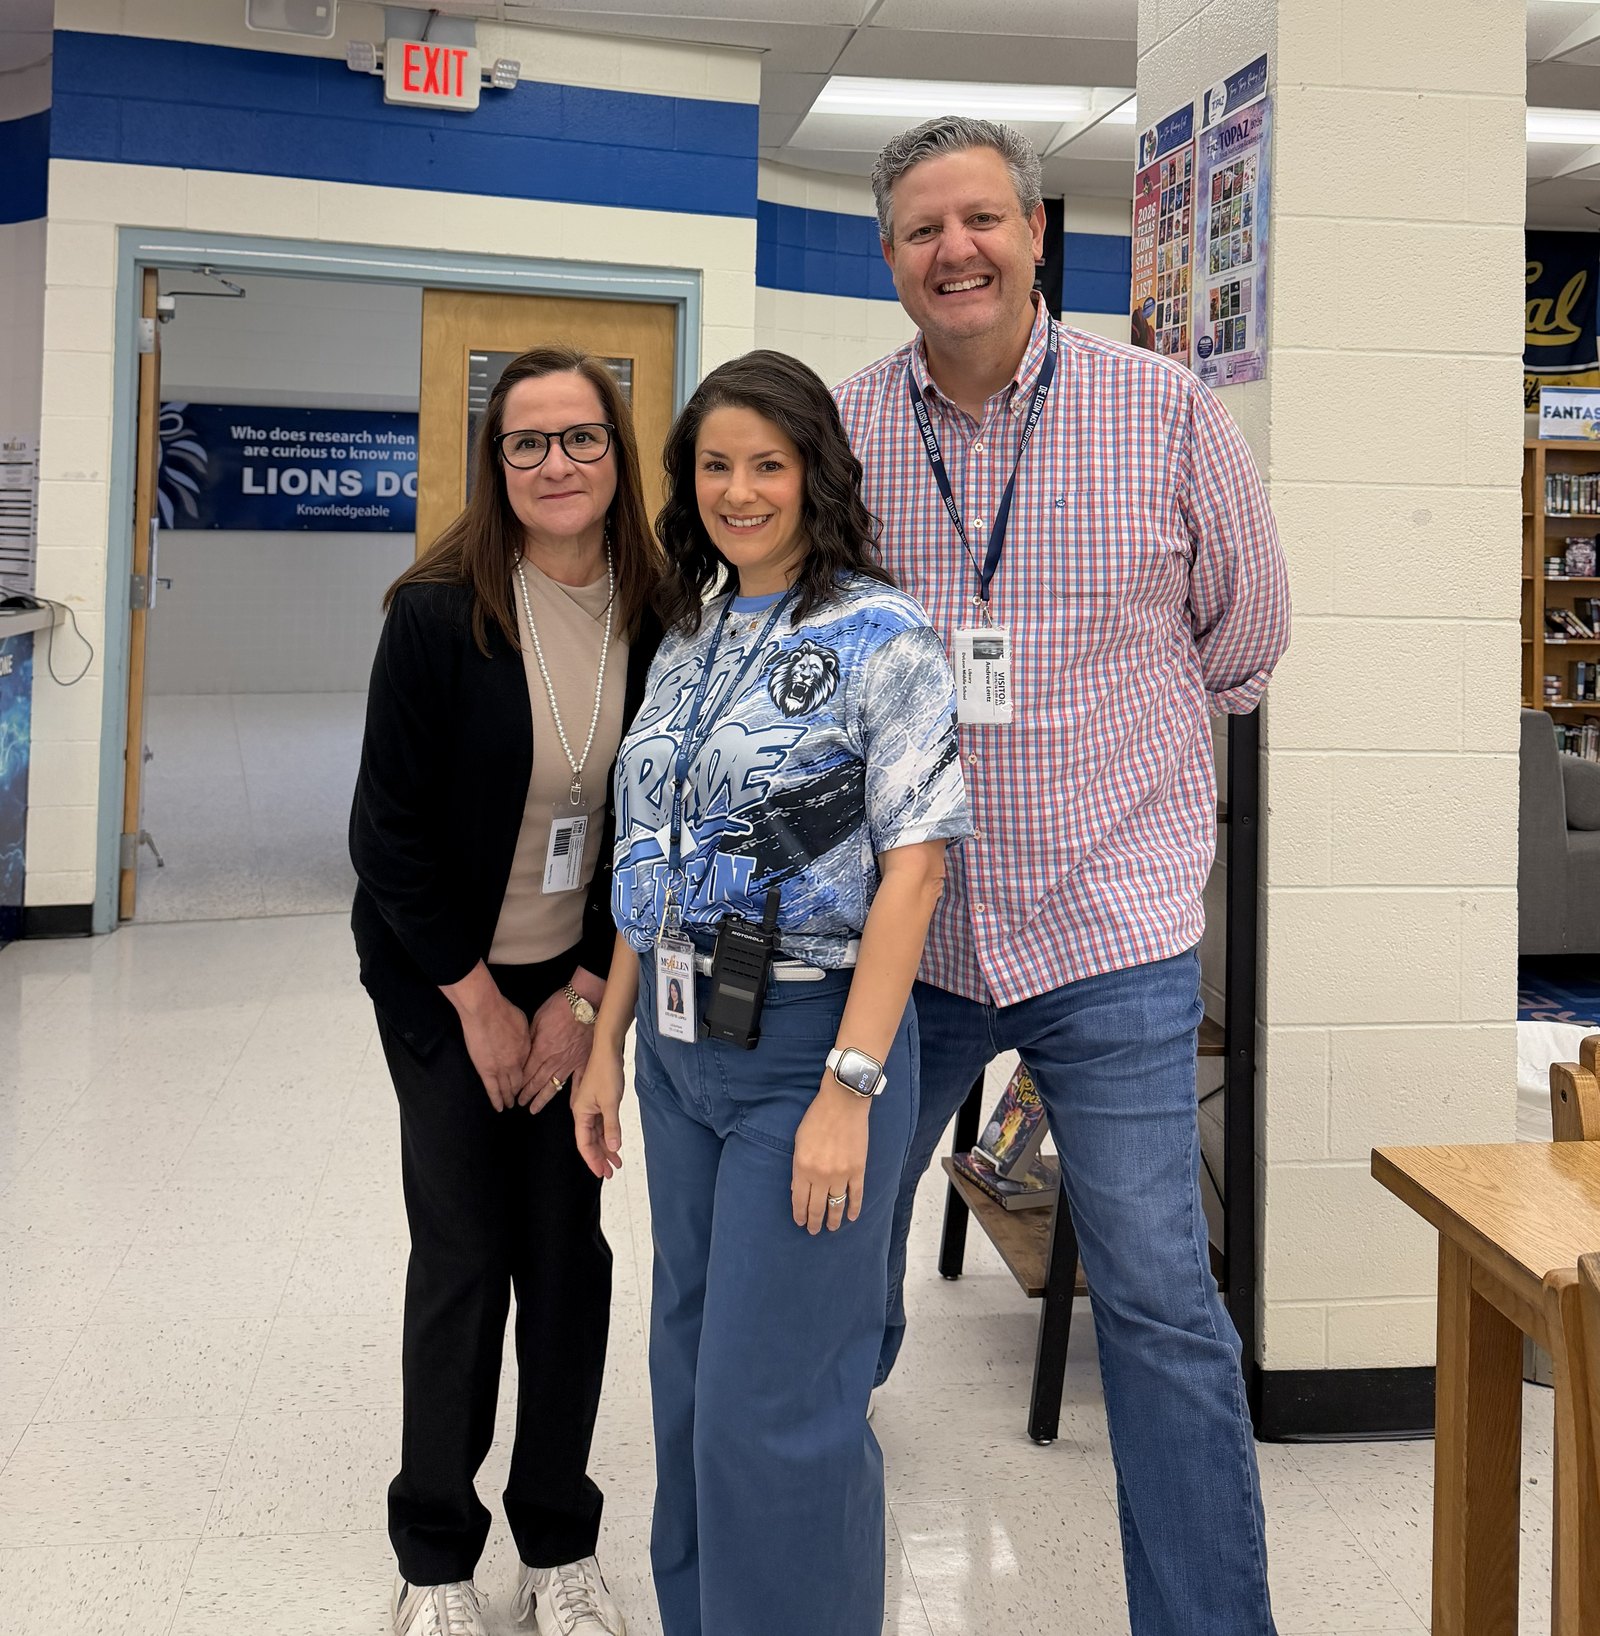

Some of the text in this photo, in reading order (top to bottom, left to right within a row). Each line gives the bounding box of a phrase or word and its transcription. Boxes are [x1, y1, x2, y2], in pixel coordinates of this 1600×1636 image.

[403, 44, 468, 97] EXIT
[1219, 119, 1250, 150] TOPAZ
[1138, 202, 1156, 224] 2026
[1137, 220, 1156, 237] TEXAS
[1136, 235, 1154, 254] LONE
[1136, 252, 1153, 270] STAR
[1136, 280, 1153, 300] LIST
[1526, 261, 1587, 346] al
[1049, 333, 1058, 353] VISITOR
[1021, 385, 1048, 450] DE LEON MS VISITOR
[230, 426, 415, 445] Who does research when
[915, 401, 941, 463] DE LEON MS VISITOR
[243, 445, 418, 461] are curious to know mo
[242, 467, 363, 497] LIONS
[296, 504, 390, 519] Knowledgeable
[998, 672, 1006, 705] VISITOR
[731, 930, 764, 943] MOTOROLA
